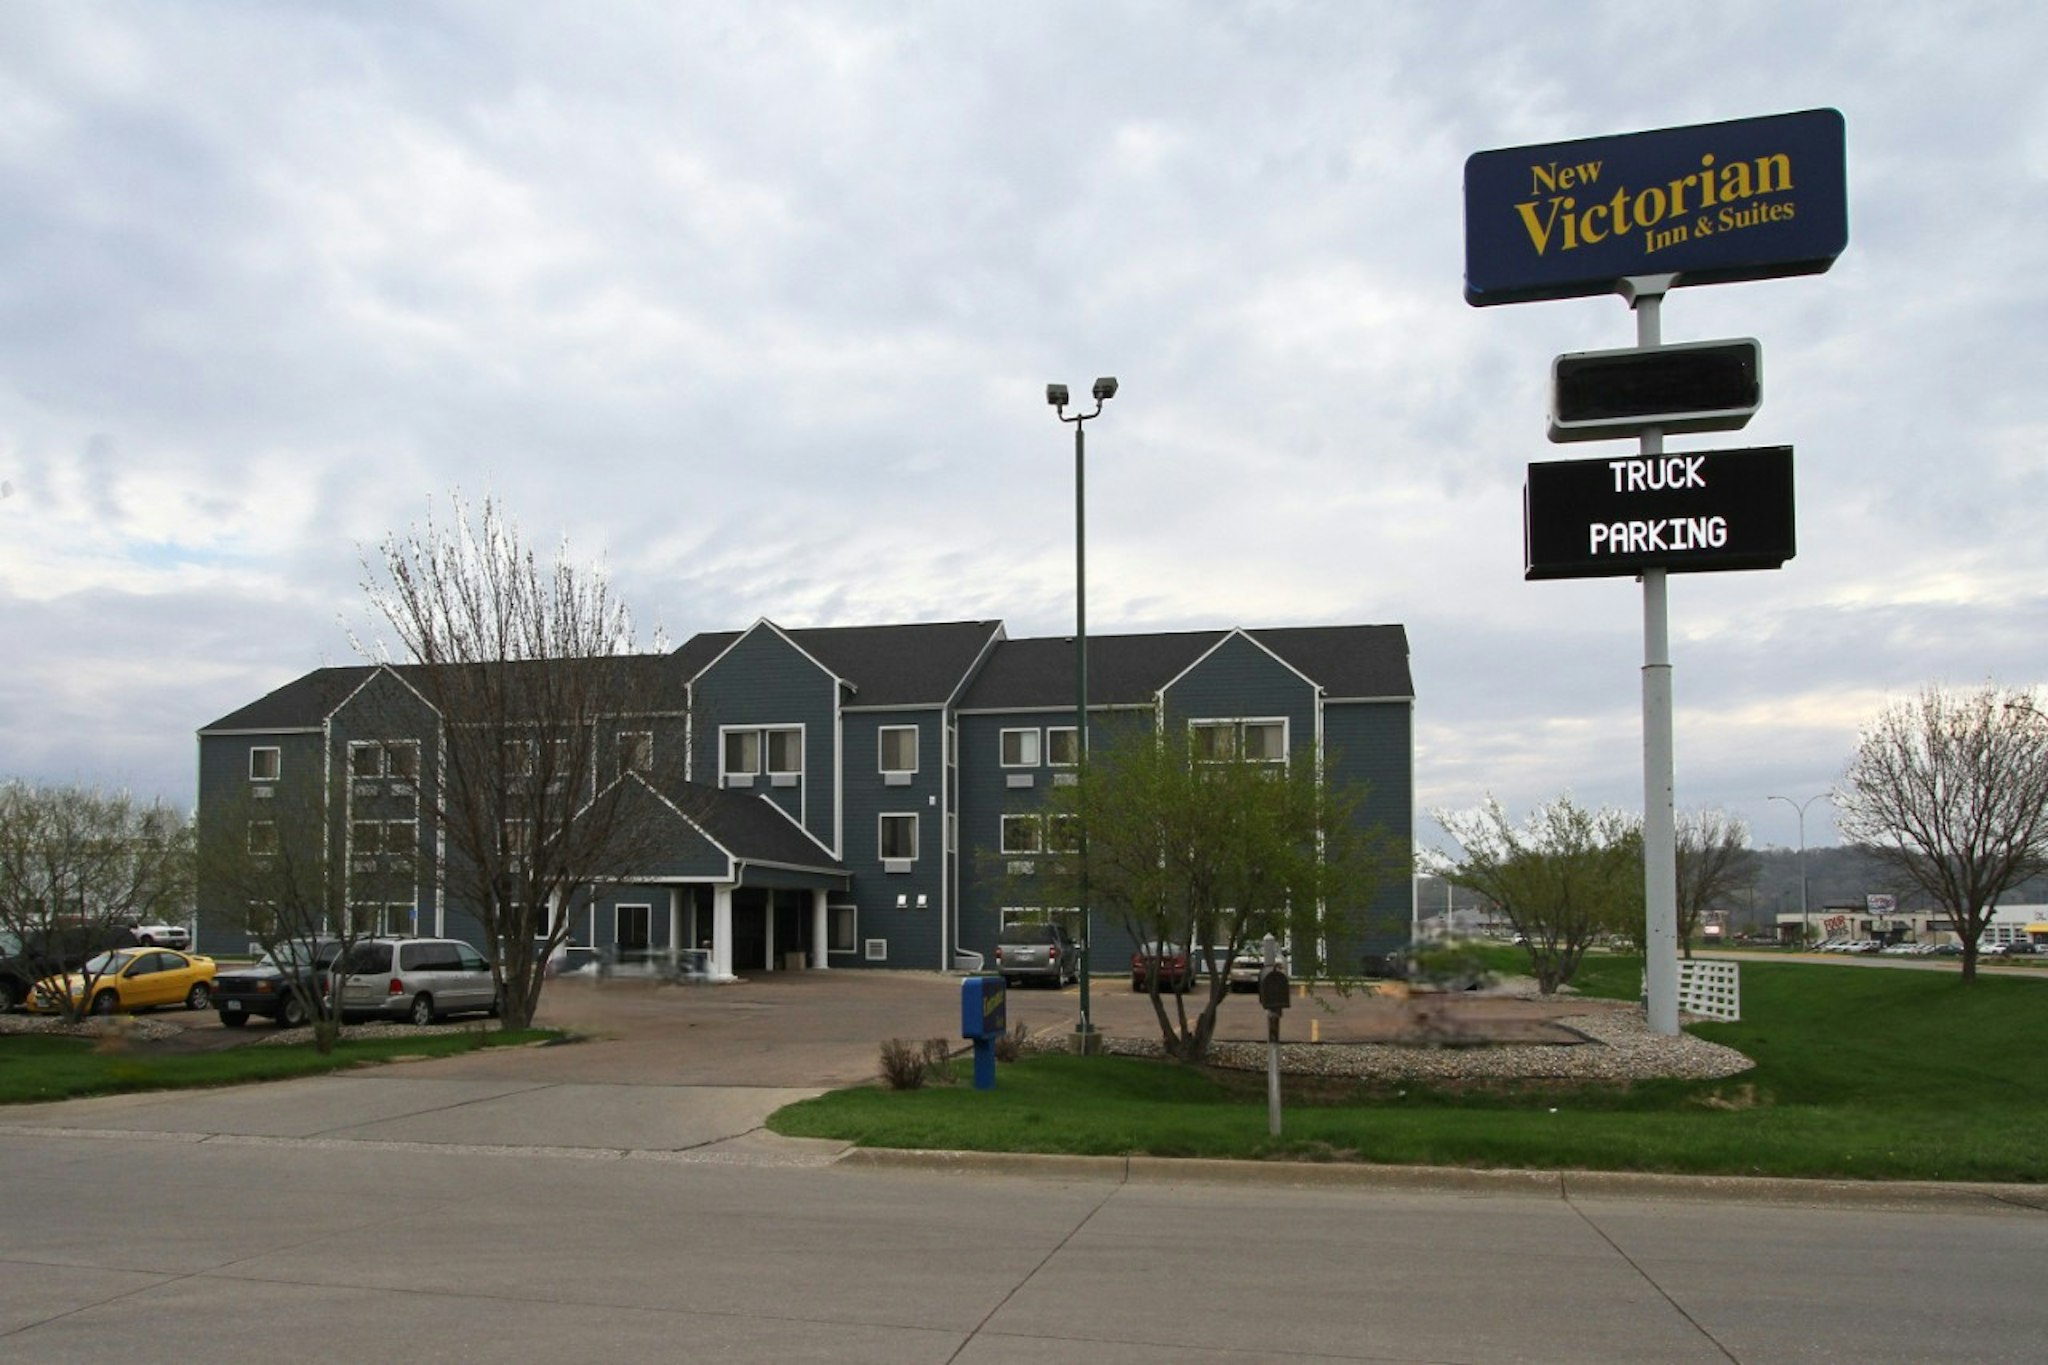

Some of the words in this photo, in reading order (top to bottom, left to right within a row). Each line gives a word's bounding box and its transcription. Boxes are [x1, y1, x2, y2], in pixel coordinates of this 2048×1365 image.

[1530, 160, 1602, 196] New
[1514, 153, 1794, 256] Victorian
[1645, 224, 1688, 254] Inn
[1694, 216, 1713, 238] &
[1718, 201, 1796, 232] Suites
[1608, 455, 1707, 493] TRUCK
[1589, 515, 1728, 555] PARKING
